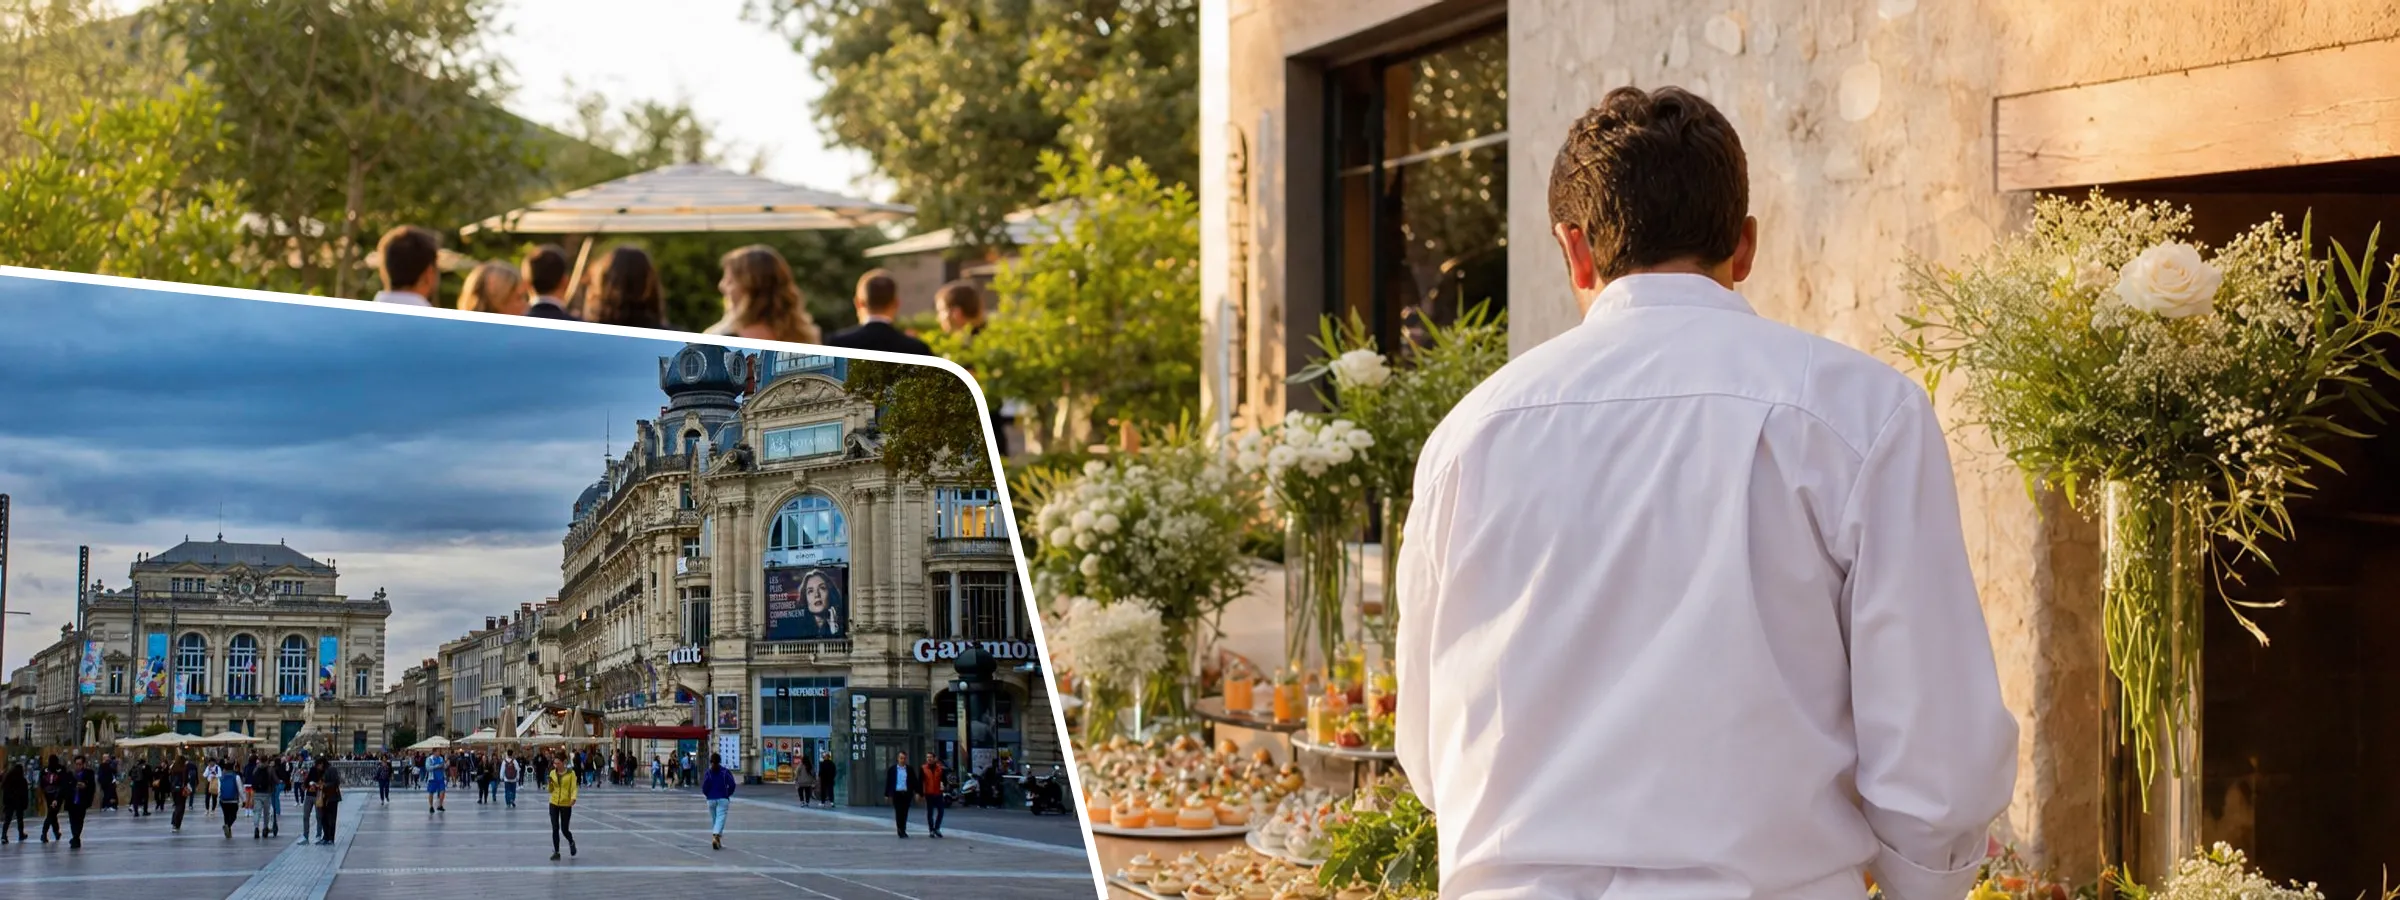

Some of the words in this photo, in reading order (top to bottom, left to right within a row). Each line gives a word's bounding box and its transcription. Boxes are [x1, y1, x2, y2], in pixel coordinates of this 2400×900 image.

[789, 436, 833, 449] NOTAIRES
[770, 576, 779, 584] LES
[770, 584, 783, 592] PLUS
[770, 601, 796, 610] HISTOIRES
[770, 609, 805, 619] COMMENCENT
[852, 694, 867, 760] Parking
